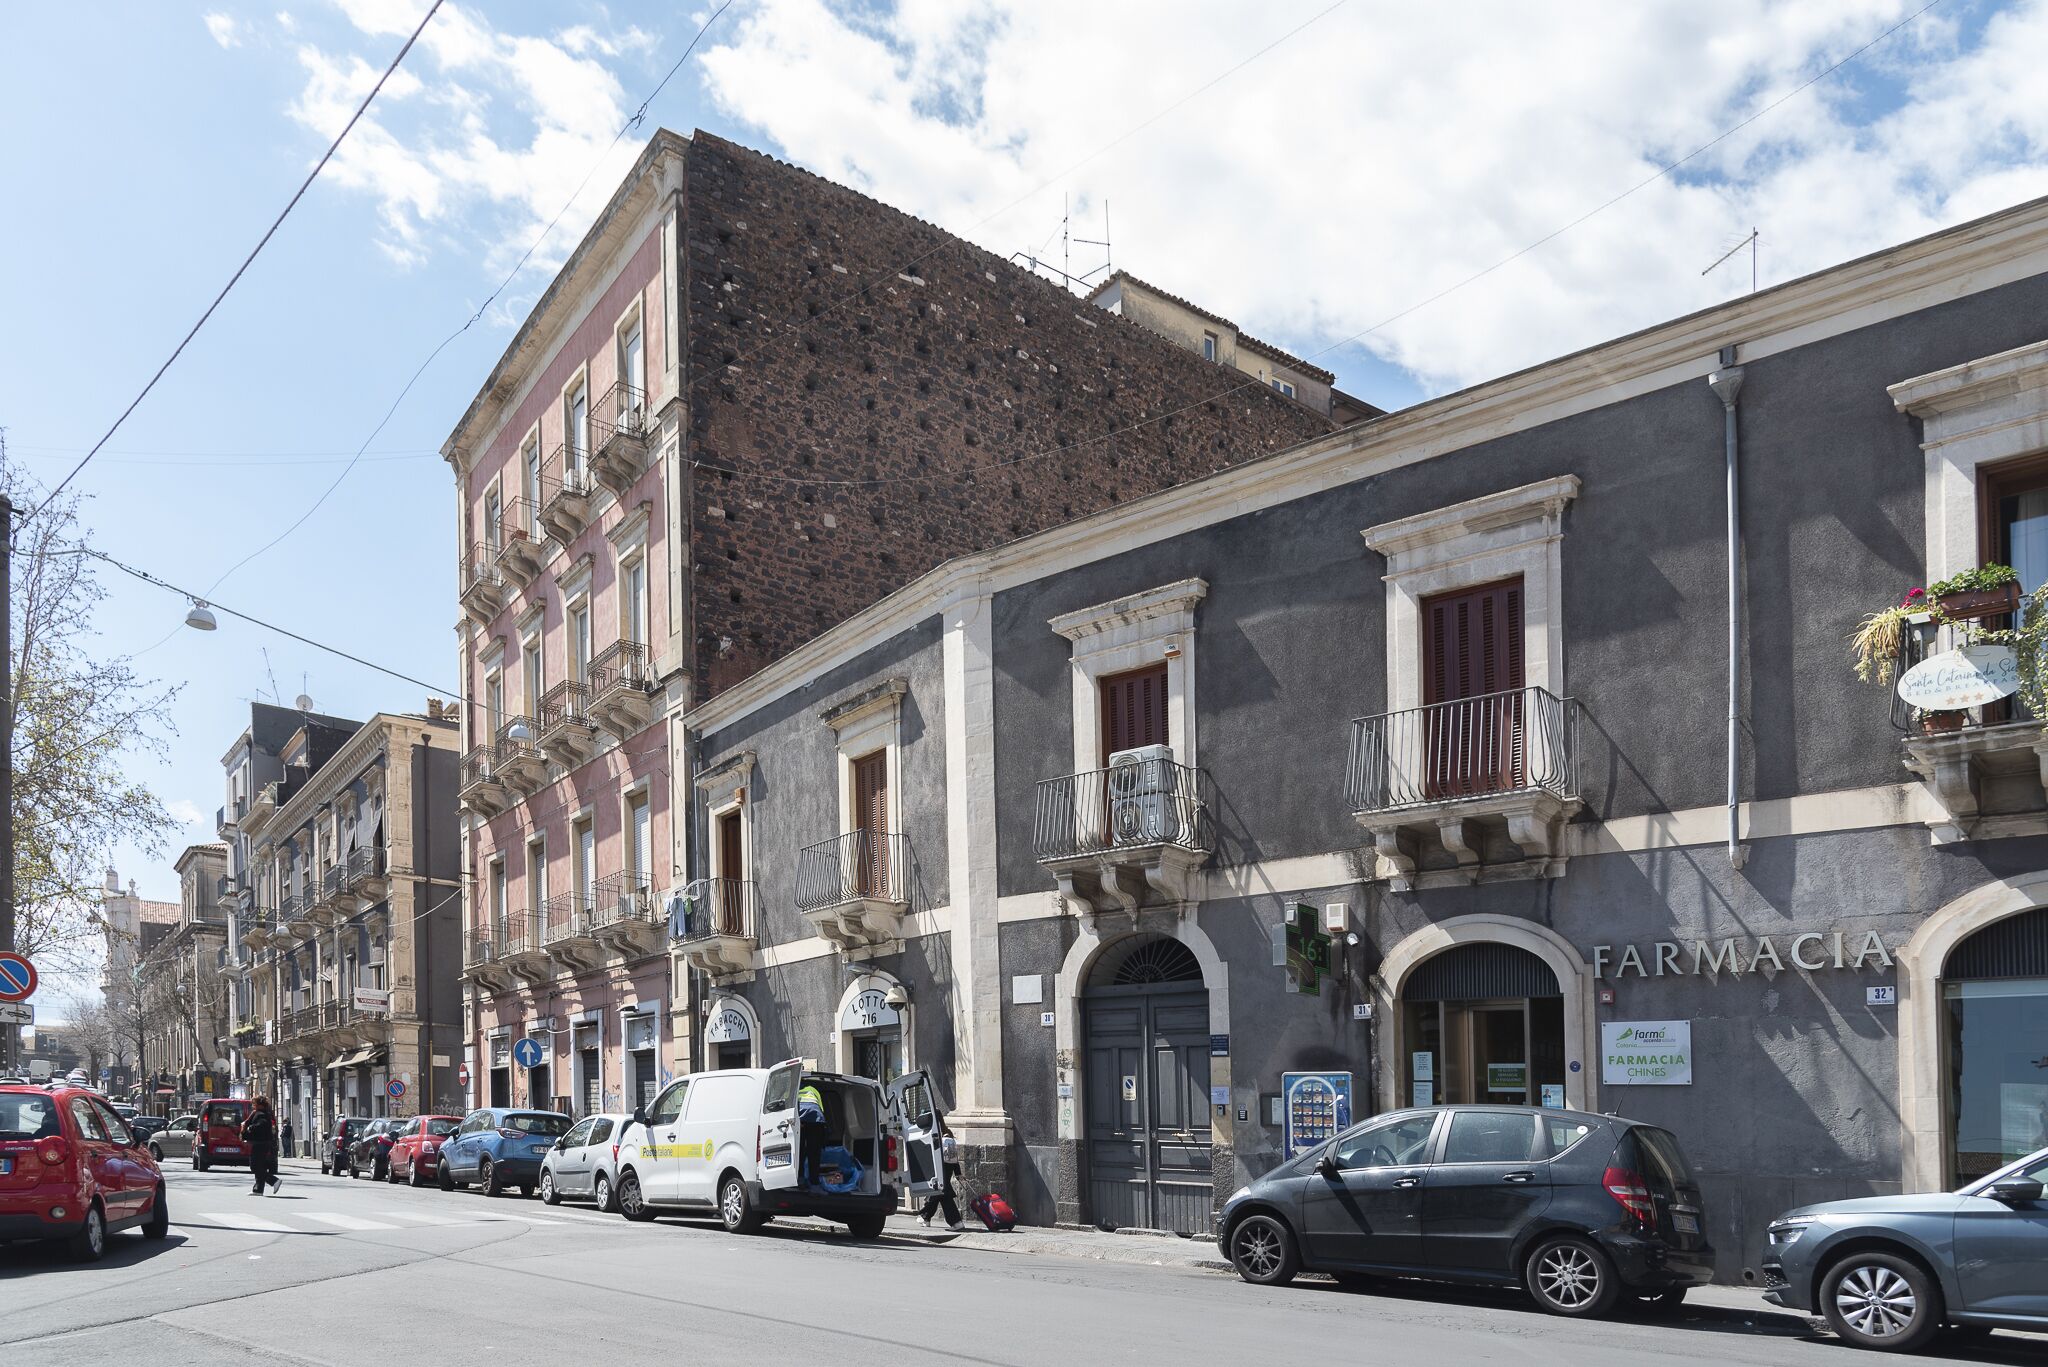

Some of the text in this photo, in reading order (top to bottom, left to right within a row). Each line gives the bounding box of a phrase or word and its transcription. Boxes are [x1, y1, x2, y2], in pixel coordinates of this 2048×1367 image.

[1902, 673, 1934, 691] Santa
[1936, 667, 1982, 687] Caterina
[1982, 662, 1996, 676] da
[1906, 676, 2017, 697] BED&BREAKFAS
[1593, 929, 1895, 979] FARMACIA
[1874, 987, 1886, 999] 32
[851, 995, 886, 1014] LOTTO
[1358, 1005, 1366, 1015] 31
[710, 1014, 746, 1037] TABACCHI
[861, 1012, 877, 1026] 716
[723, 1028, 732, 1039] 77
[1608, 1054, 1685, 1065] FARMACIA
[1627, 1067, 1666, 1077] CHINES
